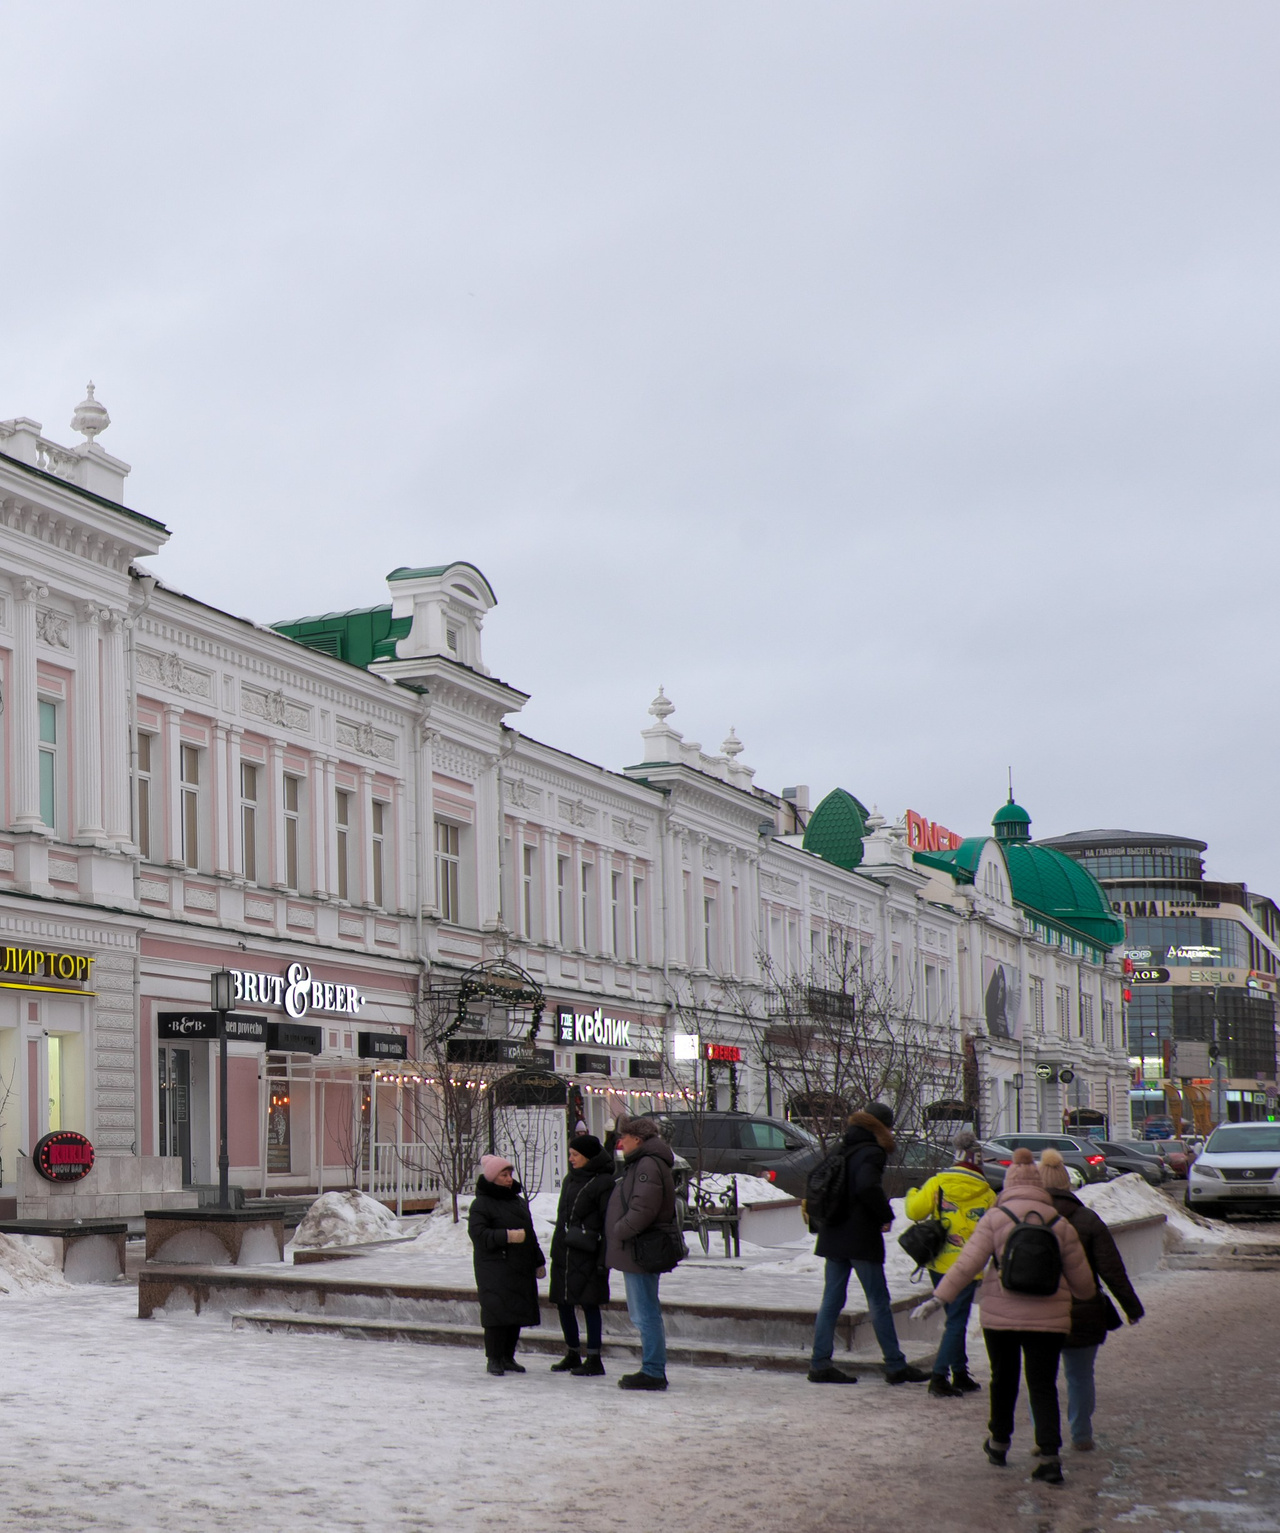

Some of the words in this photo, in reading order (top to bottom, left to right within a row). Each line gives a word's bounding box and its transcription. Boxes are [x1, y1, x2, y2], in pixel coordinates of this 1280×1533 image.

[225, 1020, 237, 1033] uen
[237, 1022, 263, 1036] provecho
[561, 1027, 573, 1040] ЖЕ
[574, 1007, 631, 1047] КРОЛИК
